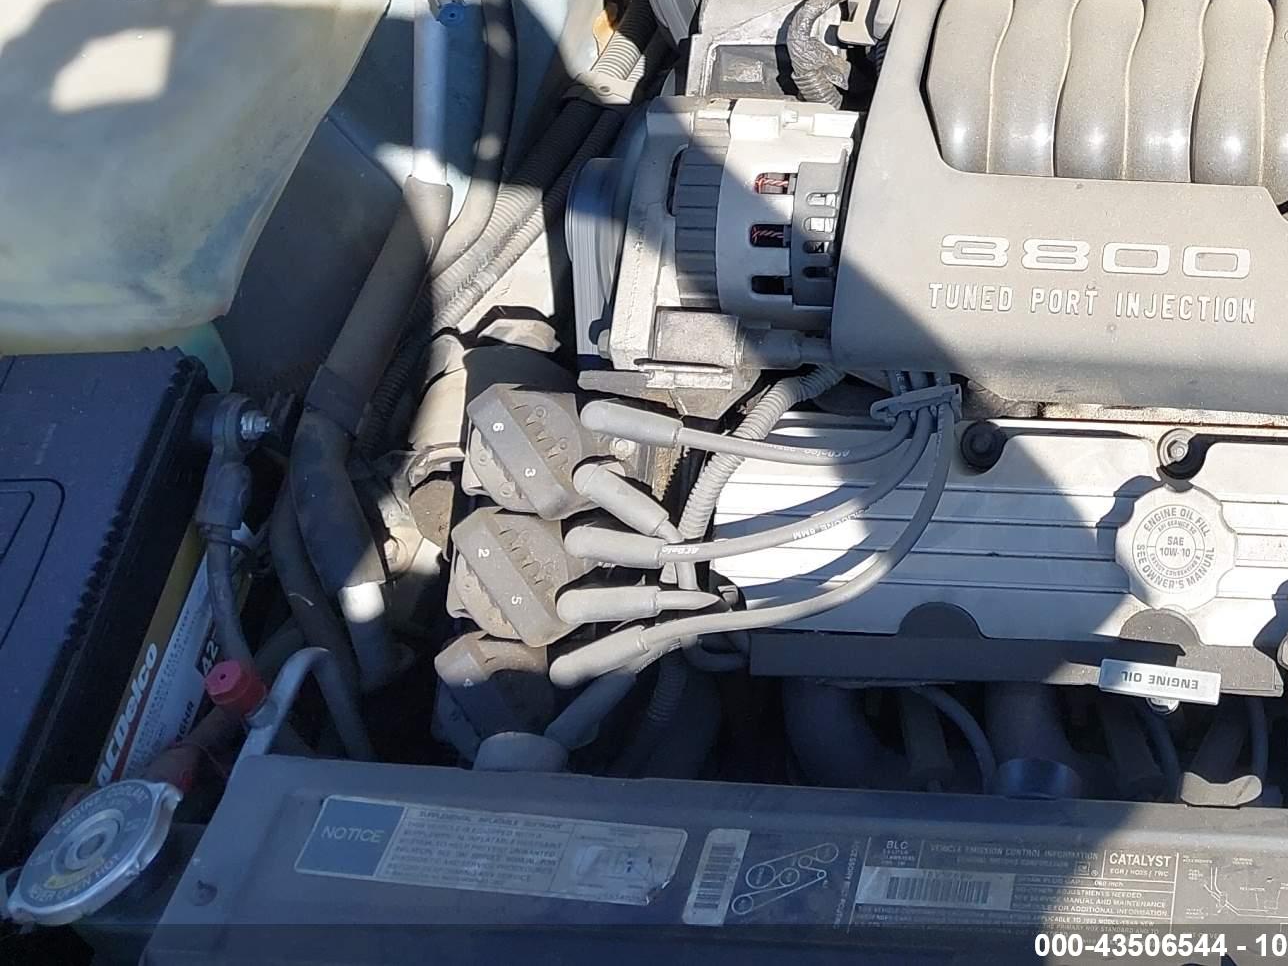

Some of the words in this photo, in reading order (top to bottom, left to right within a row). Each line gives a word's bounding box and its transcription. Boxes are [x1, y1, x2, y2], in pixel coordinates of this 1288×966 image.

[940, 234, 1252, 279] 3800
[928, 283, 1014, 313] TUNED
[1030, 287, 1100, 317] PORT
[1115, 292, 1257, 324] INJECTION
[524, 467, 537, 478] 3
[1143, 507, 1178, 533] ENGINE
[1180, 508, 1195, 521] OIL
[1195, 517, 1211, 538] FILL
[1167, 536, 1185, 546] SAE
[478, 548, 490, 558] 2
[1136, 543, 1148, 565] SEE
[1142, 563, 1185, 590] OWNER'S
[1186, 547, 1215, 587] MANUAL
[511, 595, 522, 605] 5
[1121, 671, 1142, 683] OIL
[1148, 675, 1199, 690] ENGINE
[139, 678, 164, 742] MAINTENANCE
[320, 825, 385, 843] NOTICE
[886, 840, 909, 850] BLC
[1109, 852, 1172, 867] CATALYST
[1064, 897, 1095, 905] MANUAL
[1071, 906, 1115, 914] ADDITIONAL
